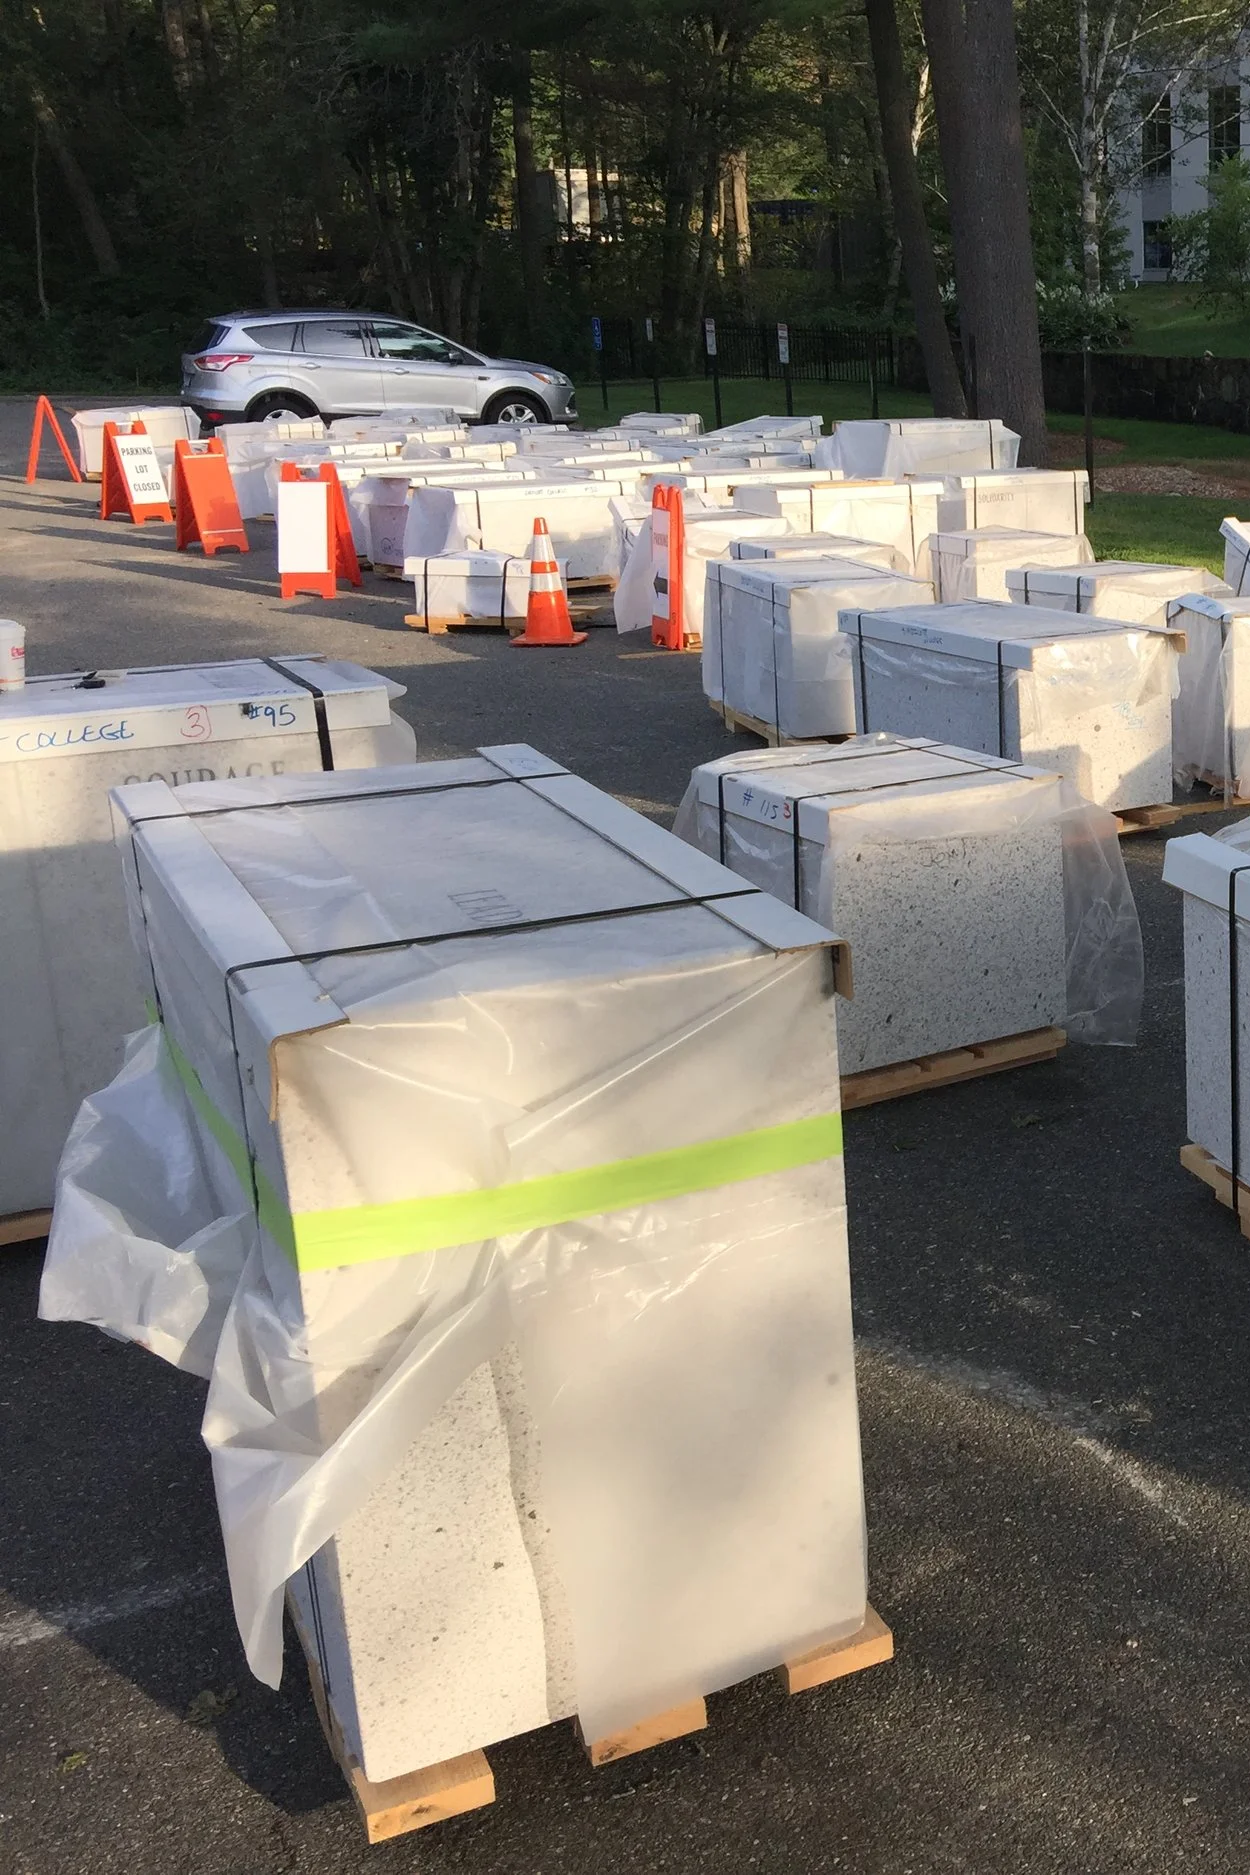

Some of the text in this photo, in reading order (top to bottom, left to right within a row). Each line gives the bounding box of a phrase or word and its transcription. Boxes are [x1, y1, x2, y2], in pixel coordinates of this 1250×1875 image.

[120, 446, 153, 457] PARKING
[134, 464, 149, 474] LOT
[133, 481, 161, 492] CLOSED
[16, 720, 135, 753] COLLEGE
[248, 703, 297, 728] #95
